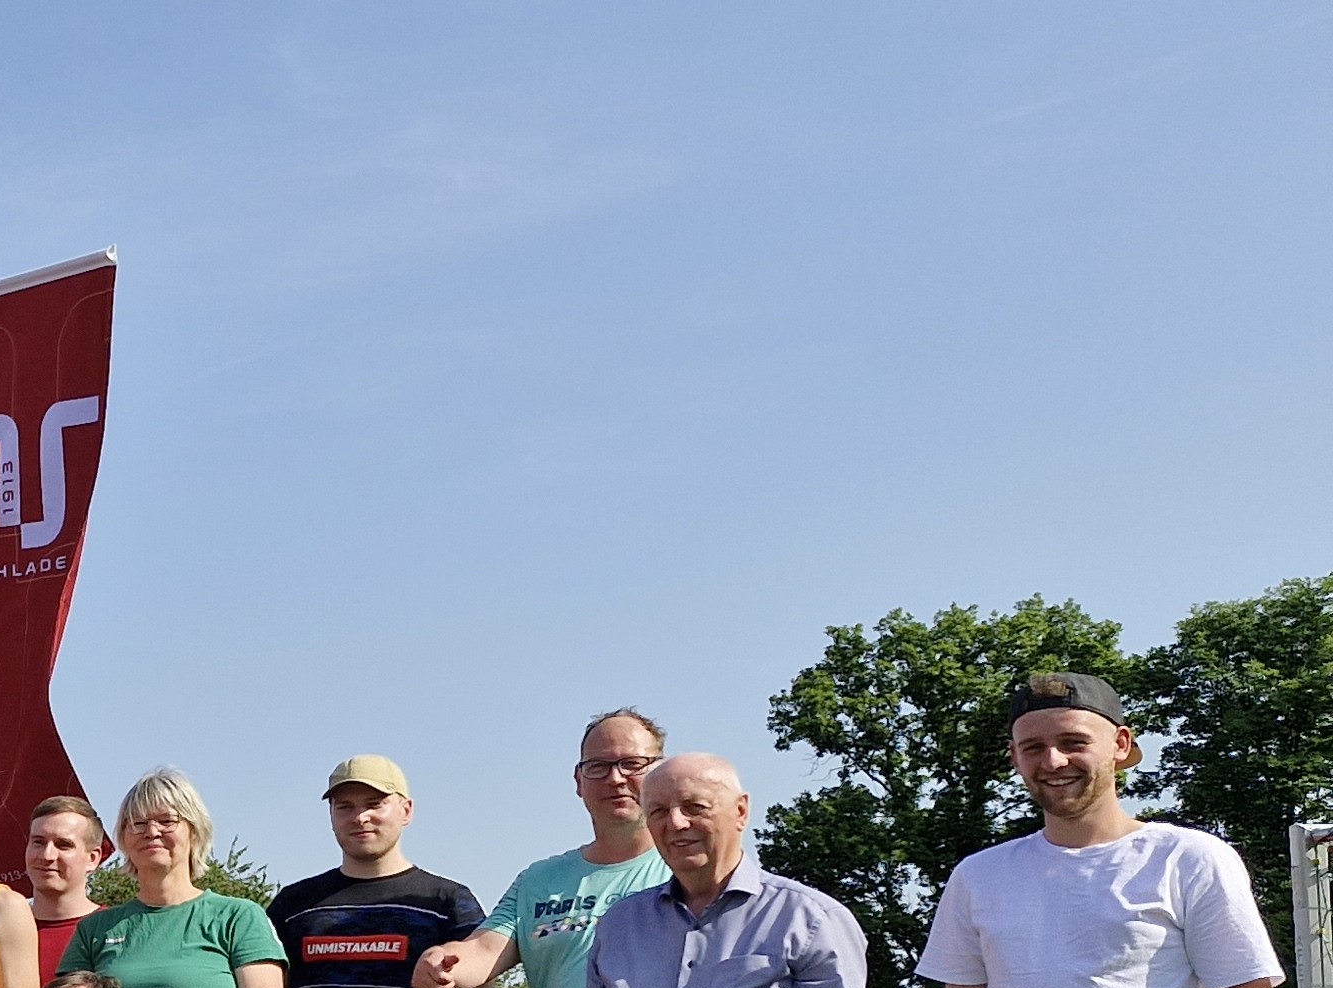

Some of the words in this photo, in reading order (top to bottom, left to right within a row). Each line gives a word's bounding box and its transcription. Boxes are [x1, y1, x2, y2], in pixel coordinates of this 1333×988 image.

[2, 460, 14, 515] 1913
[534, 895, 597, 919] PARIS
[307, 942, 402, 955] UNMISTAKABLE
